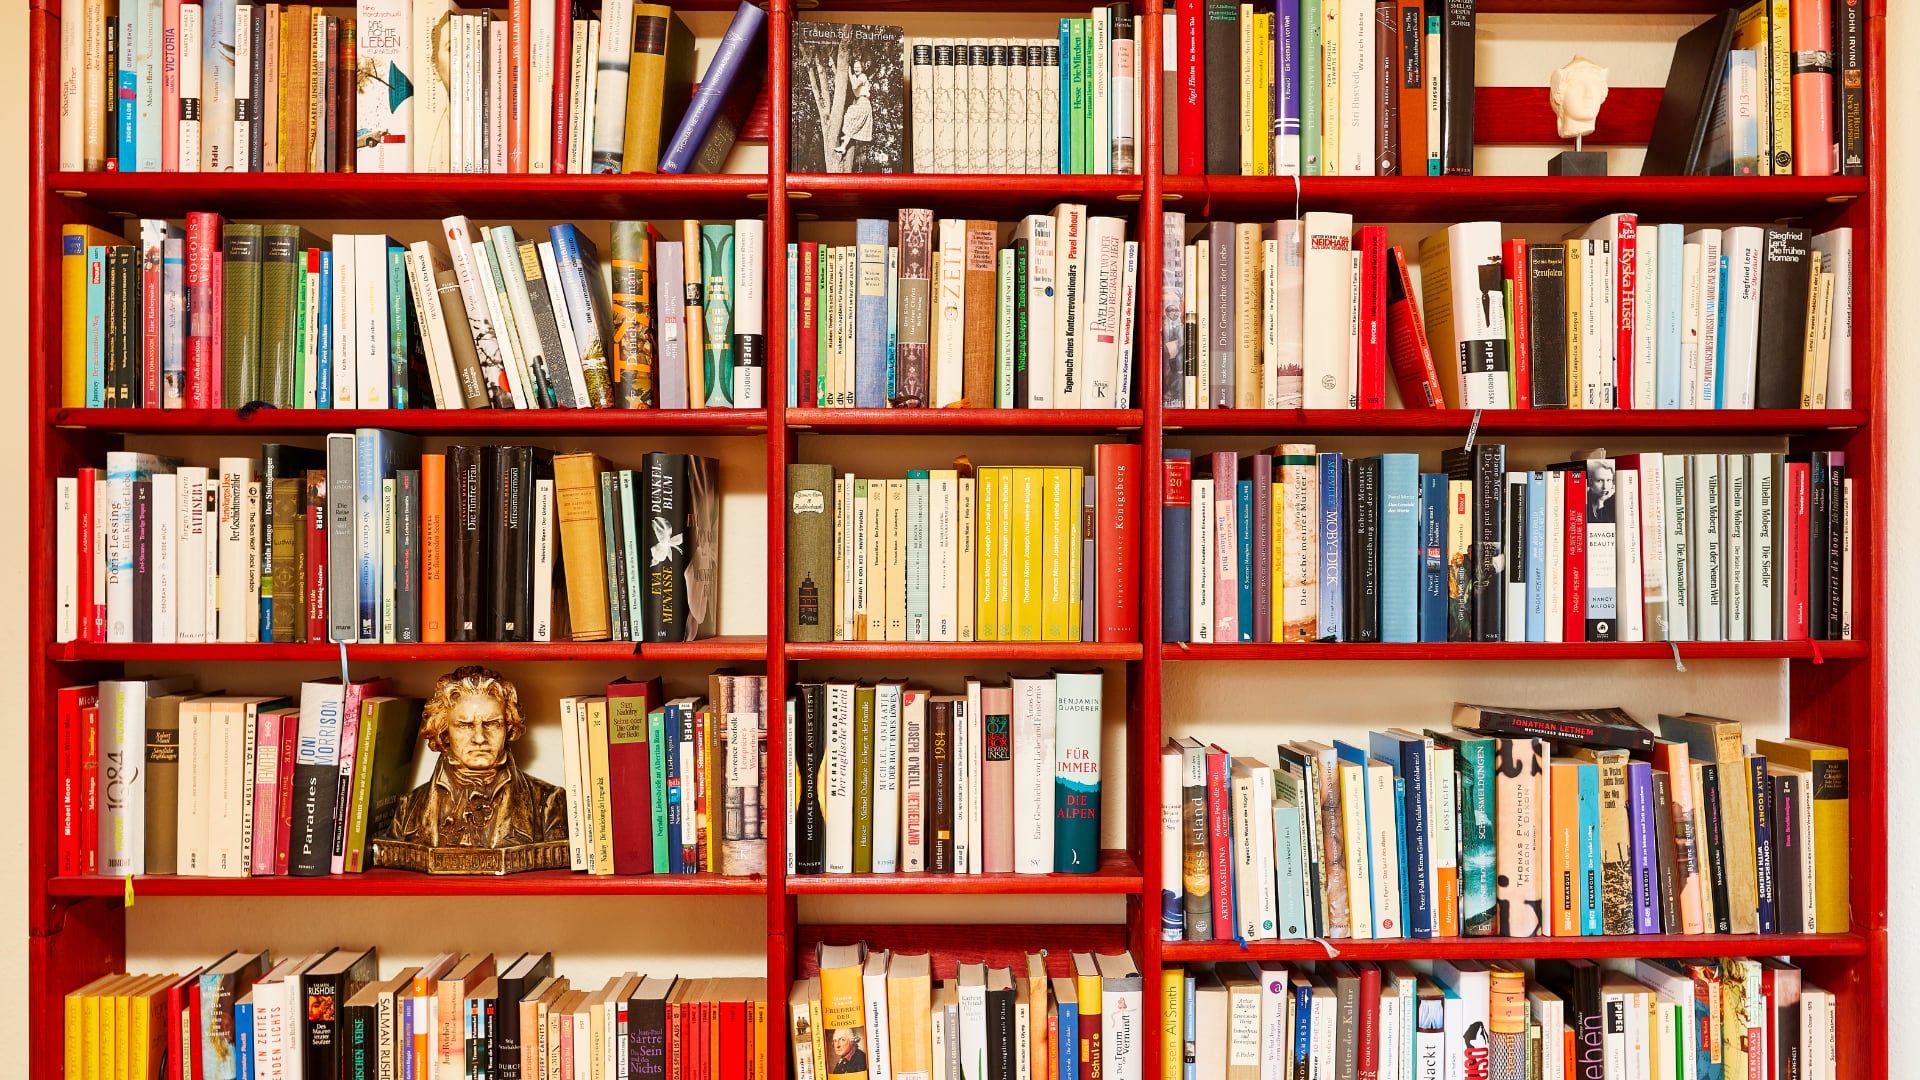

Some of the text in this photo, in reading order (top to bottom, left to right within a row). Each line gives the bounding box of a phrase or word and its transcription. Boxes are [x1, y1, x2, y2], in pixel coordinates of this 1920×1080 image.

[165, 28, 175, 72] VICTORIA
[802, 27, 836, 41] Frauen
[839, 27, 854, 40] auf
[1073, 87, 1081, 109] Hesse
[1739, 95, 1750, 118] 1913
[1352, 111, 1360, 126] Siri
[190, 224, 198, 283] GOGOLS
[1068, 211, 1079, 259] Pavel Kohout
[1311, 238, 1349, 248] NEIDHART
[1768, 239, 1787, 249] Lenz
[1768, 246, 1806, 255] Die frühen
[1769, 231, 1803, 242] Siegfried
[200, 245, 209, 283] WELT
[944, 241, 961, 299] ZEIT
[1768, 254, 1800, 263] Romane
[1107, 237, 1119, 332] HUND BEGRABEN LIEGT
[1219, 244, 1228, 346] Die Geschichte der Liebe
[1619, 248, 1635, 331] Ryska Huset
[1743, 266, 1751, 300] Siegfried
[612, 239, 651, 382] TYLL
[620, 264, 638, 366] Daniel Kehlmann
[1064, 265, 1078, 394] Tagebuch eines Konterrevolutionärs
[123, 473, 131, 496] Liebe
[468, 464, 477, 530] Die fünfte Frau
[510, 467, 519, 529] Mittsommermord
[651, 460, 662, 513] DUNKEL-
[663, 475, 673, 509] BLUM
[1115, 465, 1125, 529] Königsberg
[123, 498, 131, 511] der
[192, 483, 203, 534] BATHSEBA
[1675, 476, 1684, 536] Vilhelm Moberg
[1760, 476, 1771, 538] Vilhelm Moberg
[110, 503, 120, 584] Doris Lessing
[1677, 543, 1685, 555] Die
[651, 571, 661, 595] EVA
[1831, 560, 1838, 571] de
[662, 566, 673, 624] MENASSE
[1831, 576, 1840, 620] Margriet
[1058, 698, 1099, 706] BENJAMIN
[314, 700, 337, 765] MORRISON
[684, 711, 693, 741] PIPER
[838, 688, 848, 797] Der englische Patient
[1512, 718, 1594, 736] JONATHAN LETHEM
[297, 736, 315, 763] TONI
[730, 717, 739, 781] Lawrence Norfolk
[1057, 762, 1098, 773] IMMER
[1066, 748, 1090, 761] FÜR
[907, 721, 919, 845] JOSEPH O'NEILL NETHERLAND
[1067, 794, 1087, 806] DIE
[303, 777, 317, 855] Paradies
[1057, 807, 1095, 819] ALPEN
[1442, 777, 1450, 831] ROSENGIFT
[1757, 787, 1765, 828] ROONEY
[1192, 797, 1205, 886] Miss Island
[1516, 784, 1524, 887] THOMAS PYNCHON
[1219, 846, 1228, 920] ARTO PAASILINNA
[1763, 840, 1772, 903] CONVERSATIONS
[1247, 924, 1255, 937] dtv
[307, 986, 336, 995] RUSHDIE
[825, 1006, 861, 1014] FRIEDRICH
[1166, 986, 1177, 1035] Ali Smith
[1614, 1002, 1624, 1033] PIPER
[354, 1018, 365, 1050] VERSE
[630, 1033, 663, 1045] Sartre
[640, 1046, 662, 1057] Sein
[1115, 1031, 1123, 1061] Traum
[1122, 1014, 1130, 1054] Vernunft
[630, 1062, 662, 1074] Nichts
[1092, 1033, 1101, 1078] Schulze
